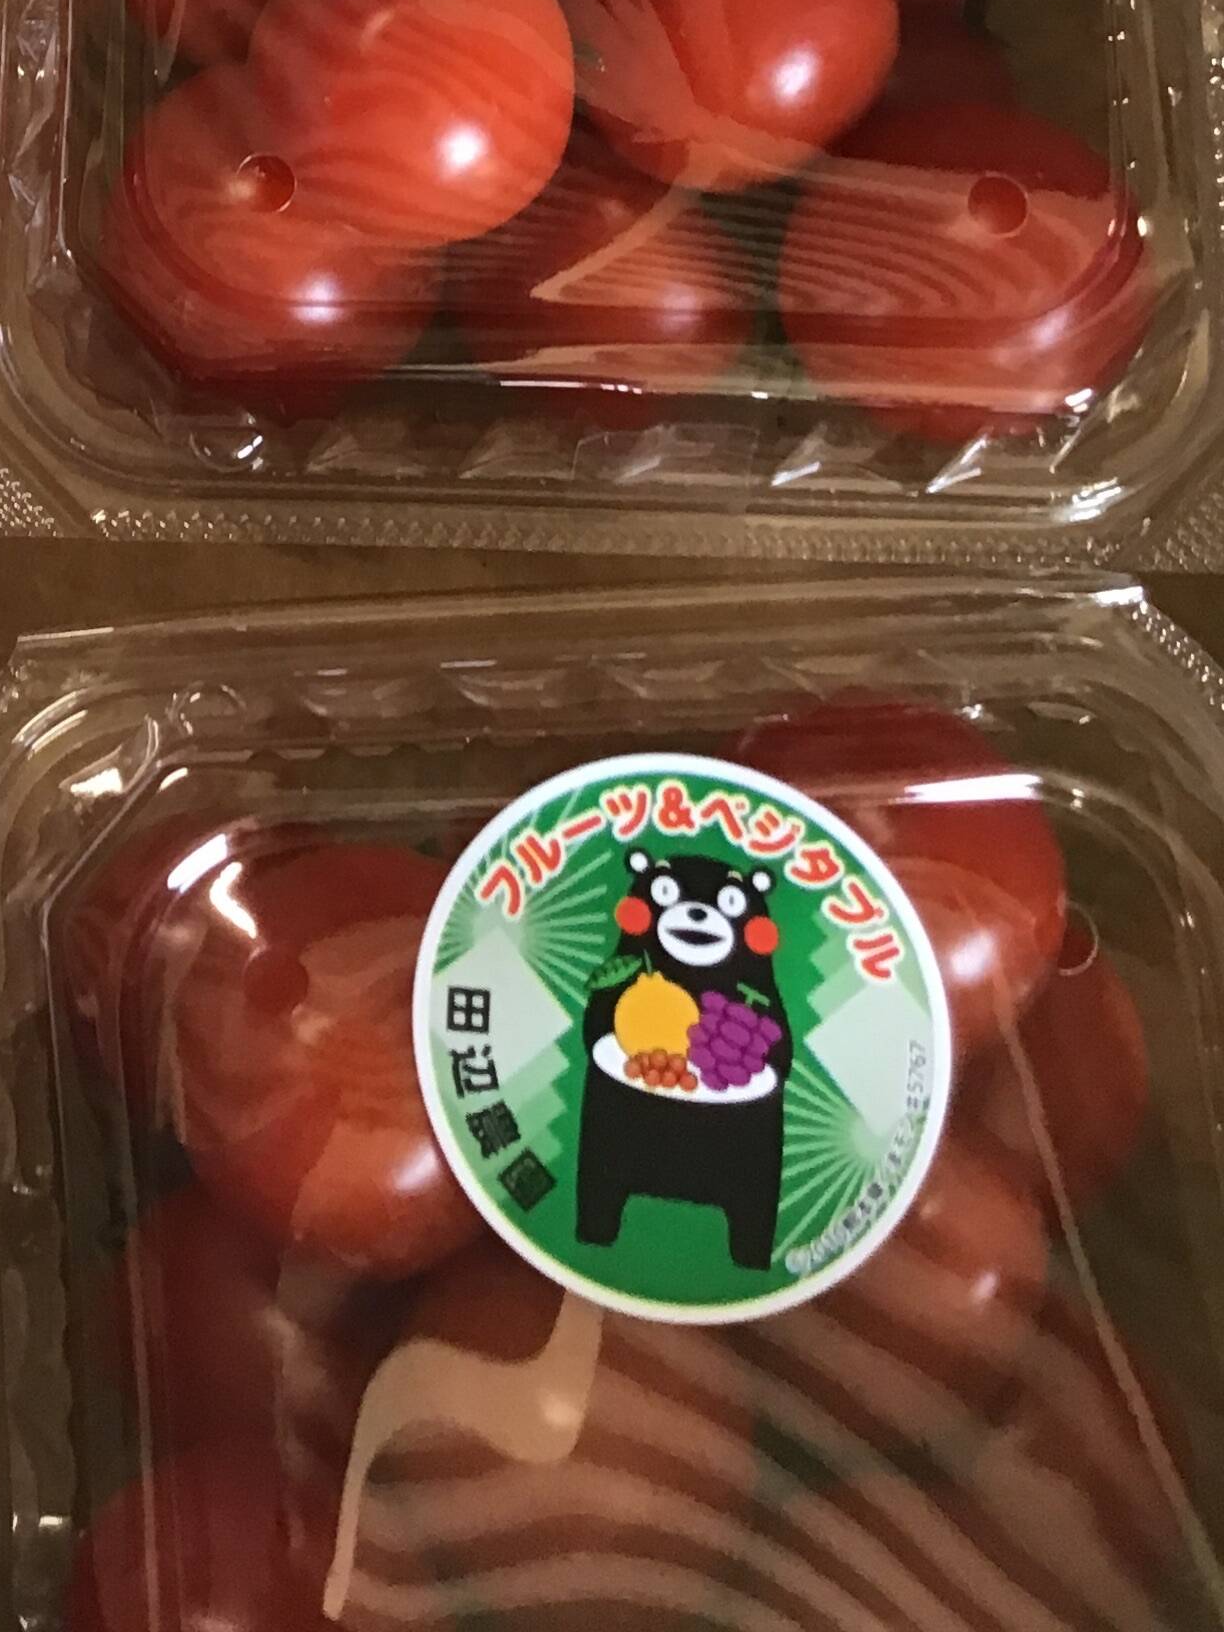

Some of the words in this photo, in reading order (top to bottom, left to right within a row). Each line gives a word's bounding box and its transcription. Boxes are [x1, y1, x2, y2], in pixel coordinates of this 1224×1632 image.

[480, 785, 901, 979] フルーツ&ベジタブル
